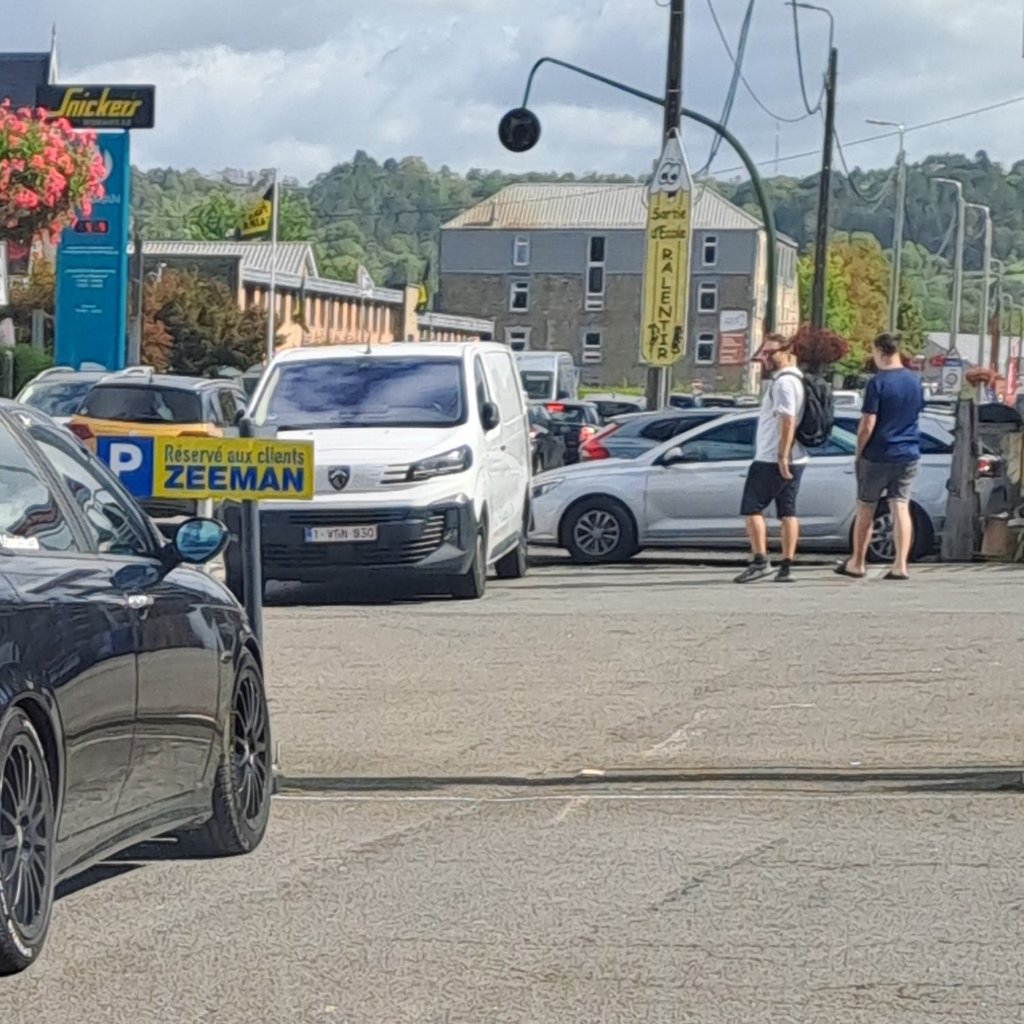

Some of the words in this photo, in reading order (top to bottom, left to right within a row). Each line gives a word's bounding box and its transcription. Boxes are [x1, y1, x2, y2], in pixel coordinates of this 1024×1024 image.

[657, 248, 673, 359] RALENTIR
[164, 444, 222, 463] Réservé
[227, 450, 252, 463] aux
[257, 446, 305, 465] clients
[164, 465, 305, 492] ZEEMAN
